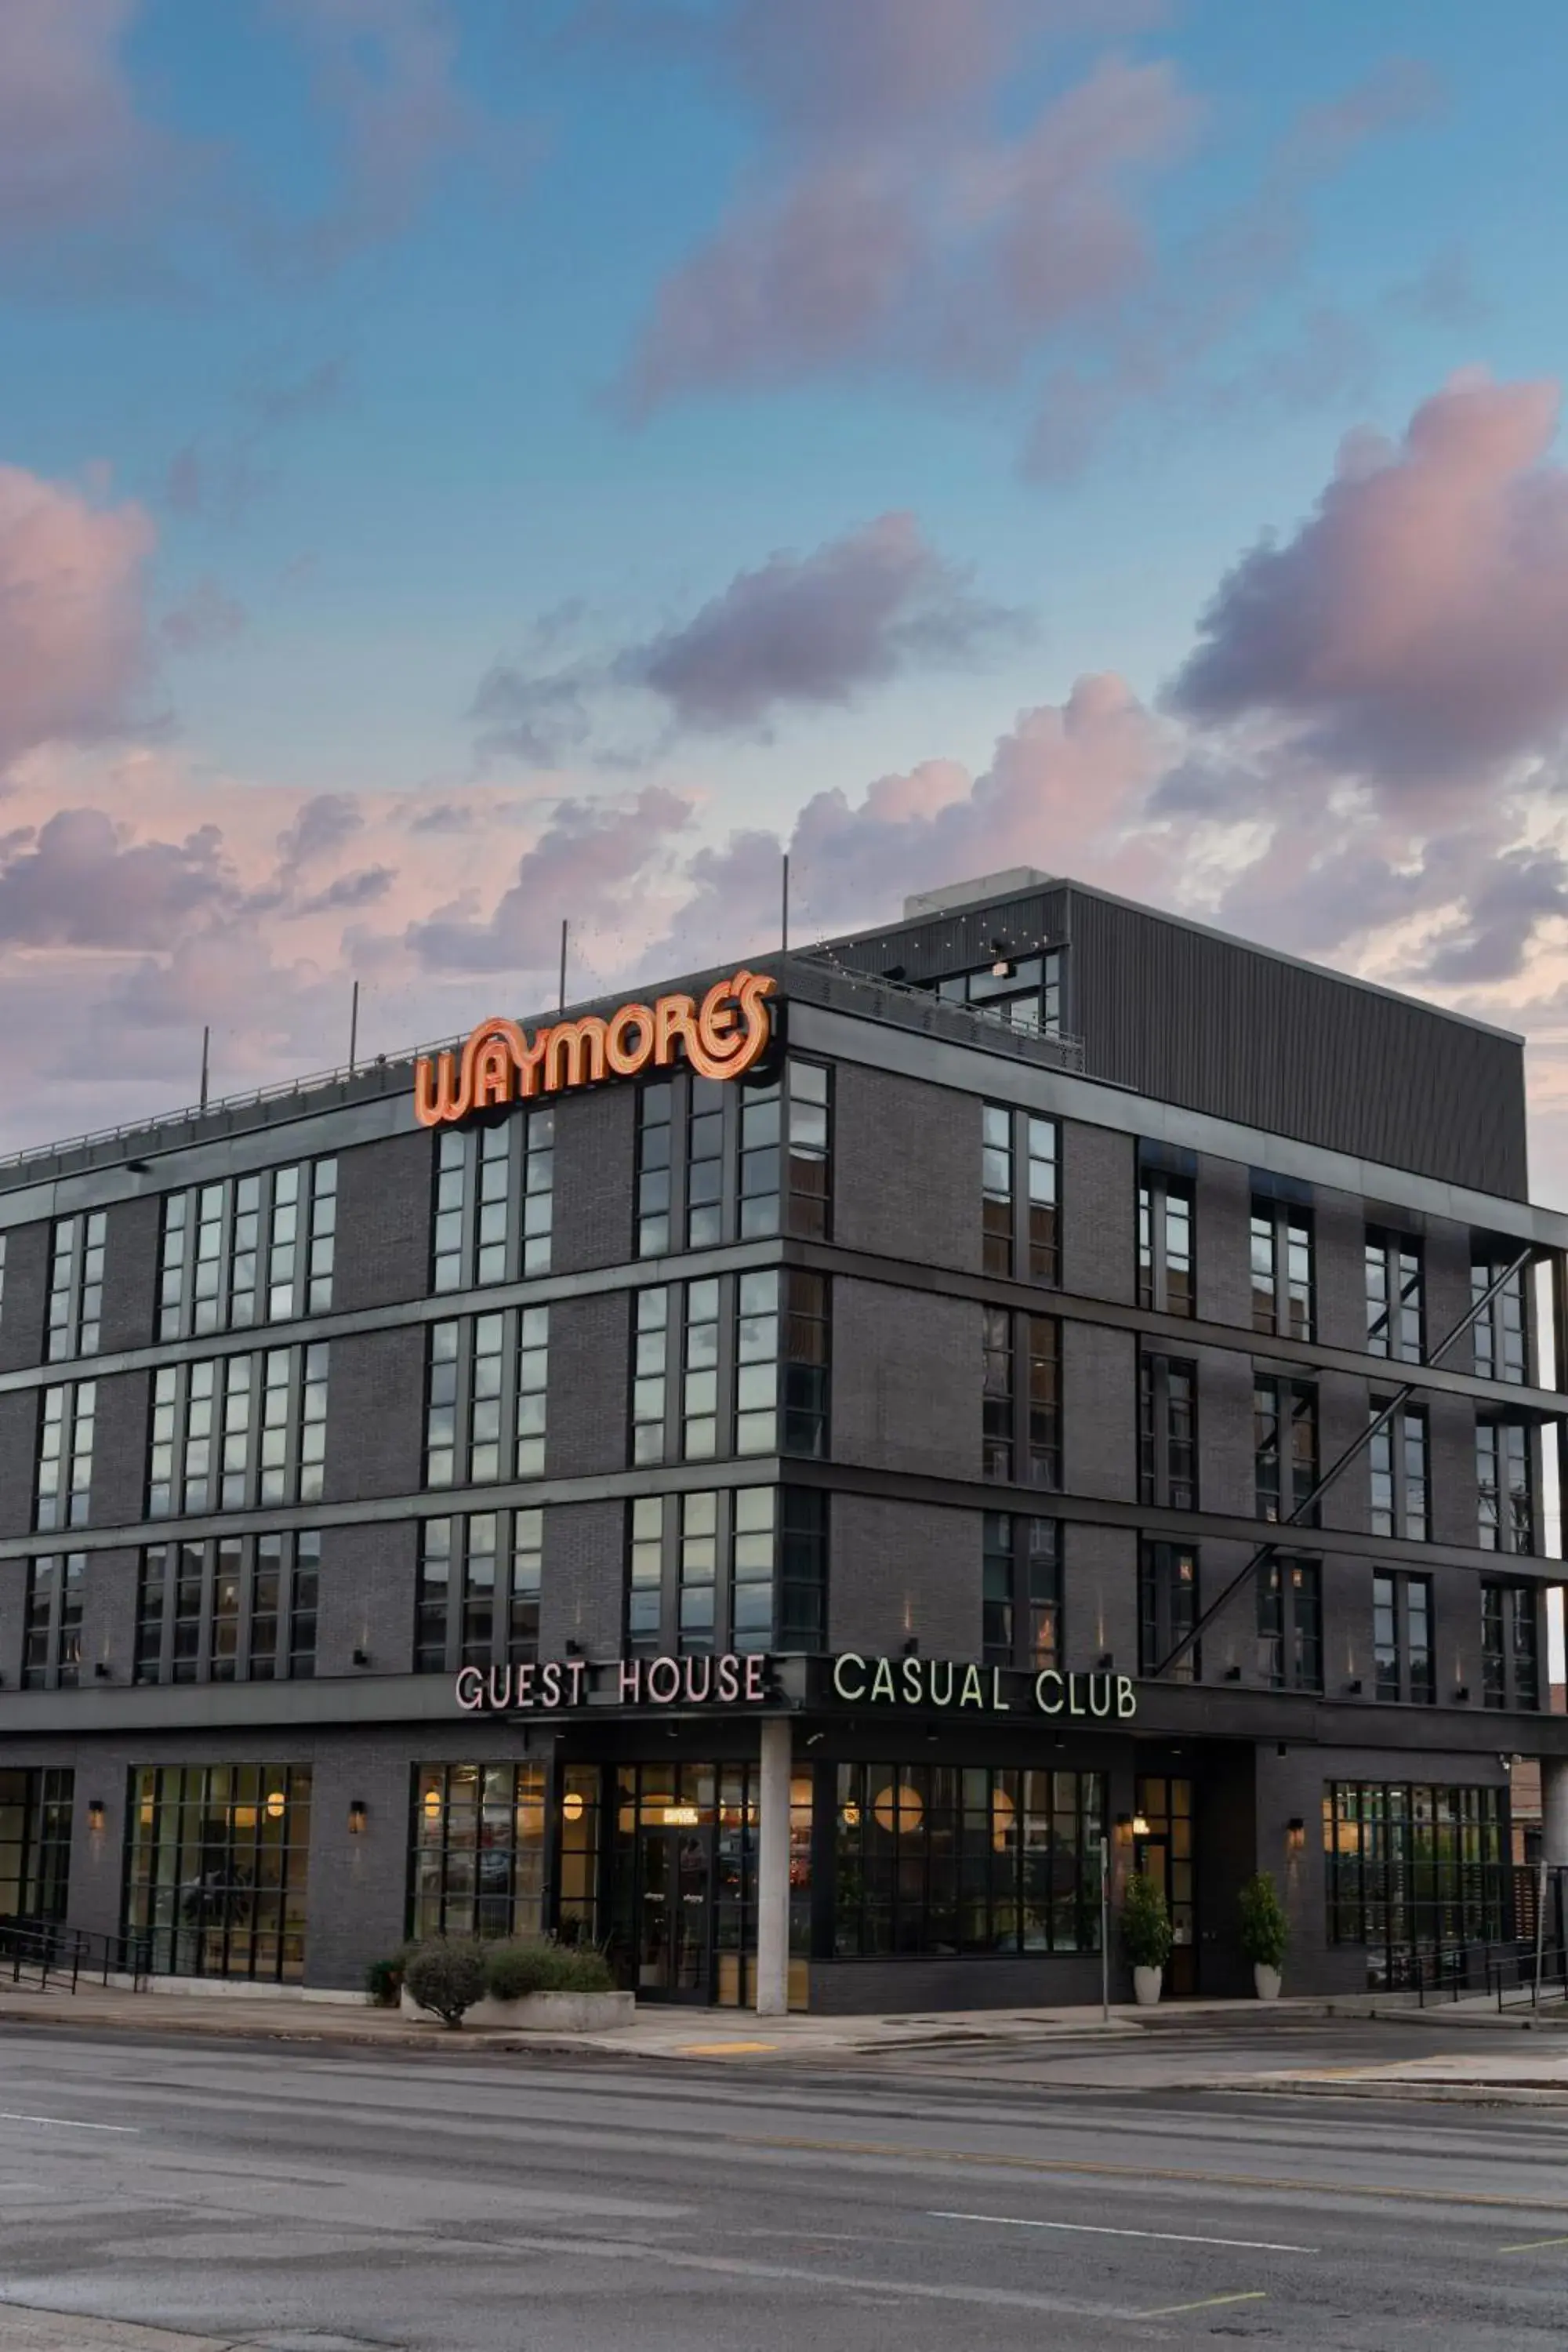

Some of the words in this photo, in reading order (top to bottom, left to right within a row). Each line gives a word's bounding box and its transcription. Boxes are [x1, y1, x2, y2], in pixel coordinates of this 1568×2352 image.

[456, 1662, 585, 1710] GUEST
[619, 1653, 765, 1704] HOUSE
[833, 1652, 1010, 1711] CASUAL
[1036, 1669, 1137, 1718] CLUB
